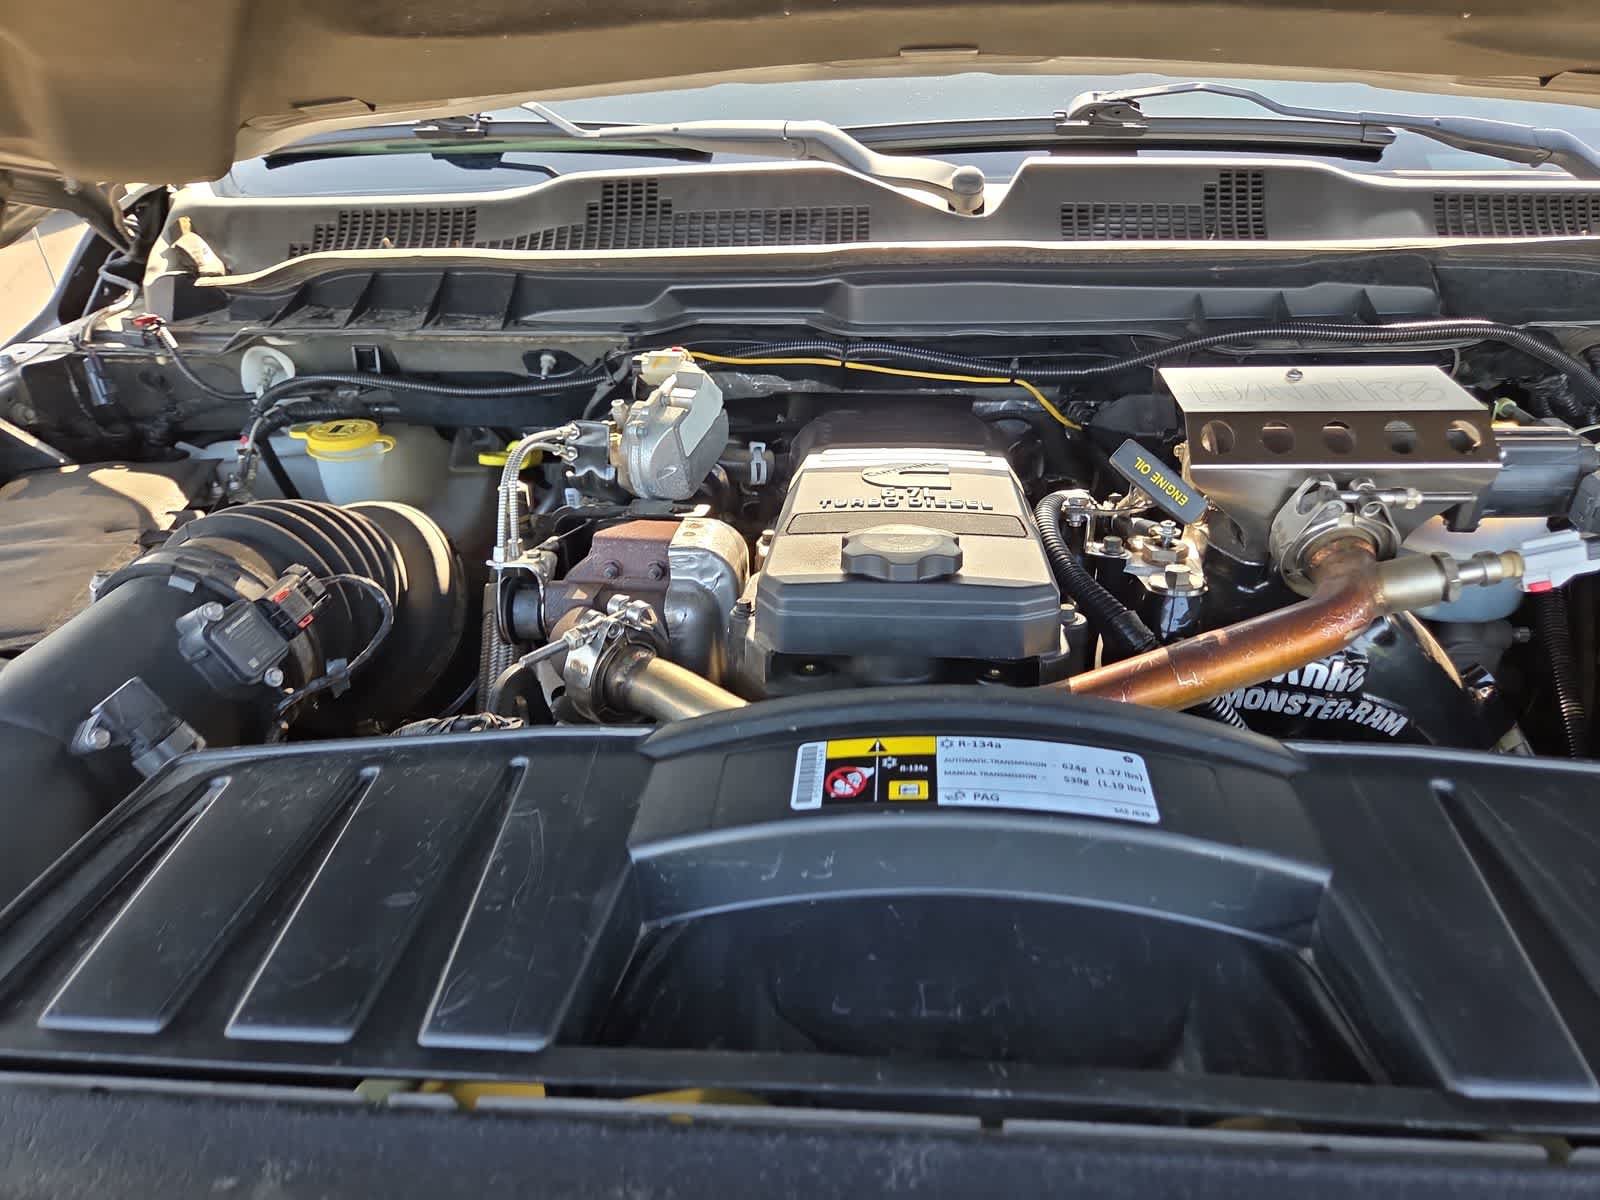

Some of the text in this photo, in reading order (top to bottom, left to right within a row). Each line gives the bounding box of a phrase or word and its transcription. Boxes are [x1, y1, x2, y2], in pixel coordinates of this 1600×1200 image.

[1133, 456, 1189, 507] ENGINE OIL
[881, 487, 935, 500] 6.7L
[819, 498, 993, 511] TURBO DIESEL
[958, 740, 1002, 749] R-134a
[943, 756, 989, 765] AUTOMATIC
[990, 758, 1047, 768] TRANSMISSION
[943, 769, 978, 777] MANUAL
[980, 770, 1037, 780] TRANSMISSION
[973, 791, 1000, 801] PAG
